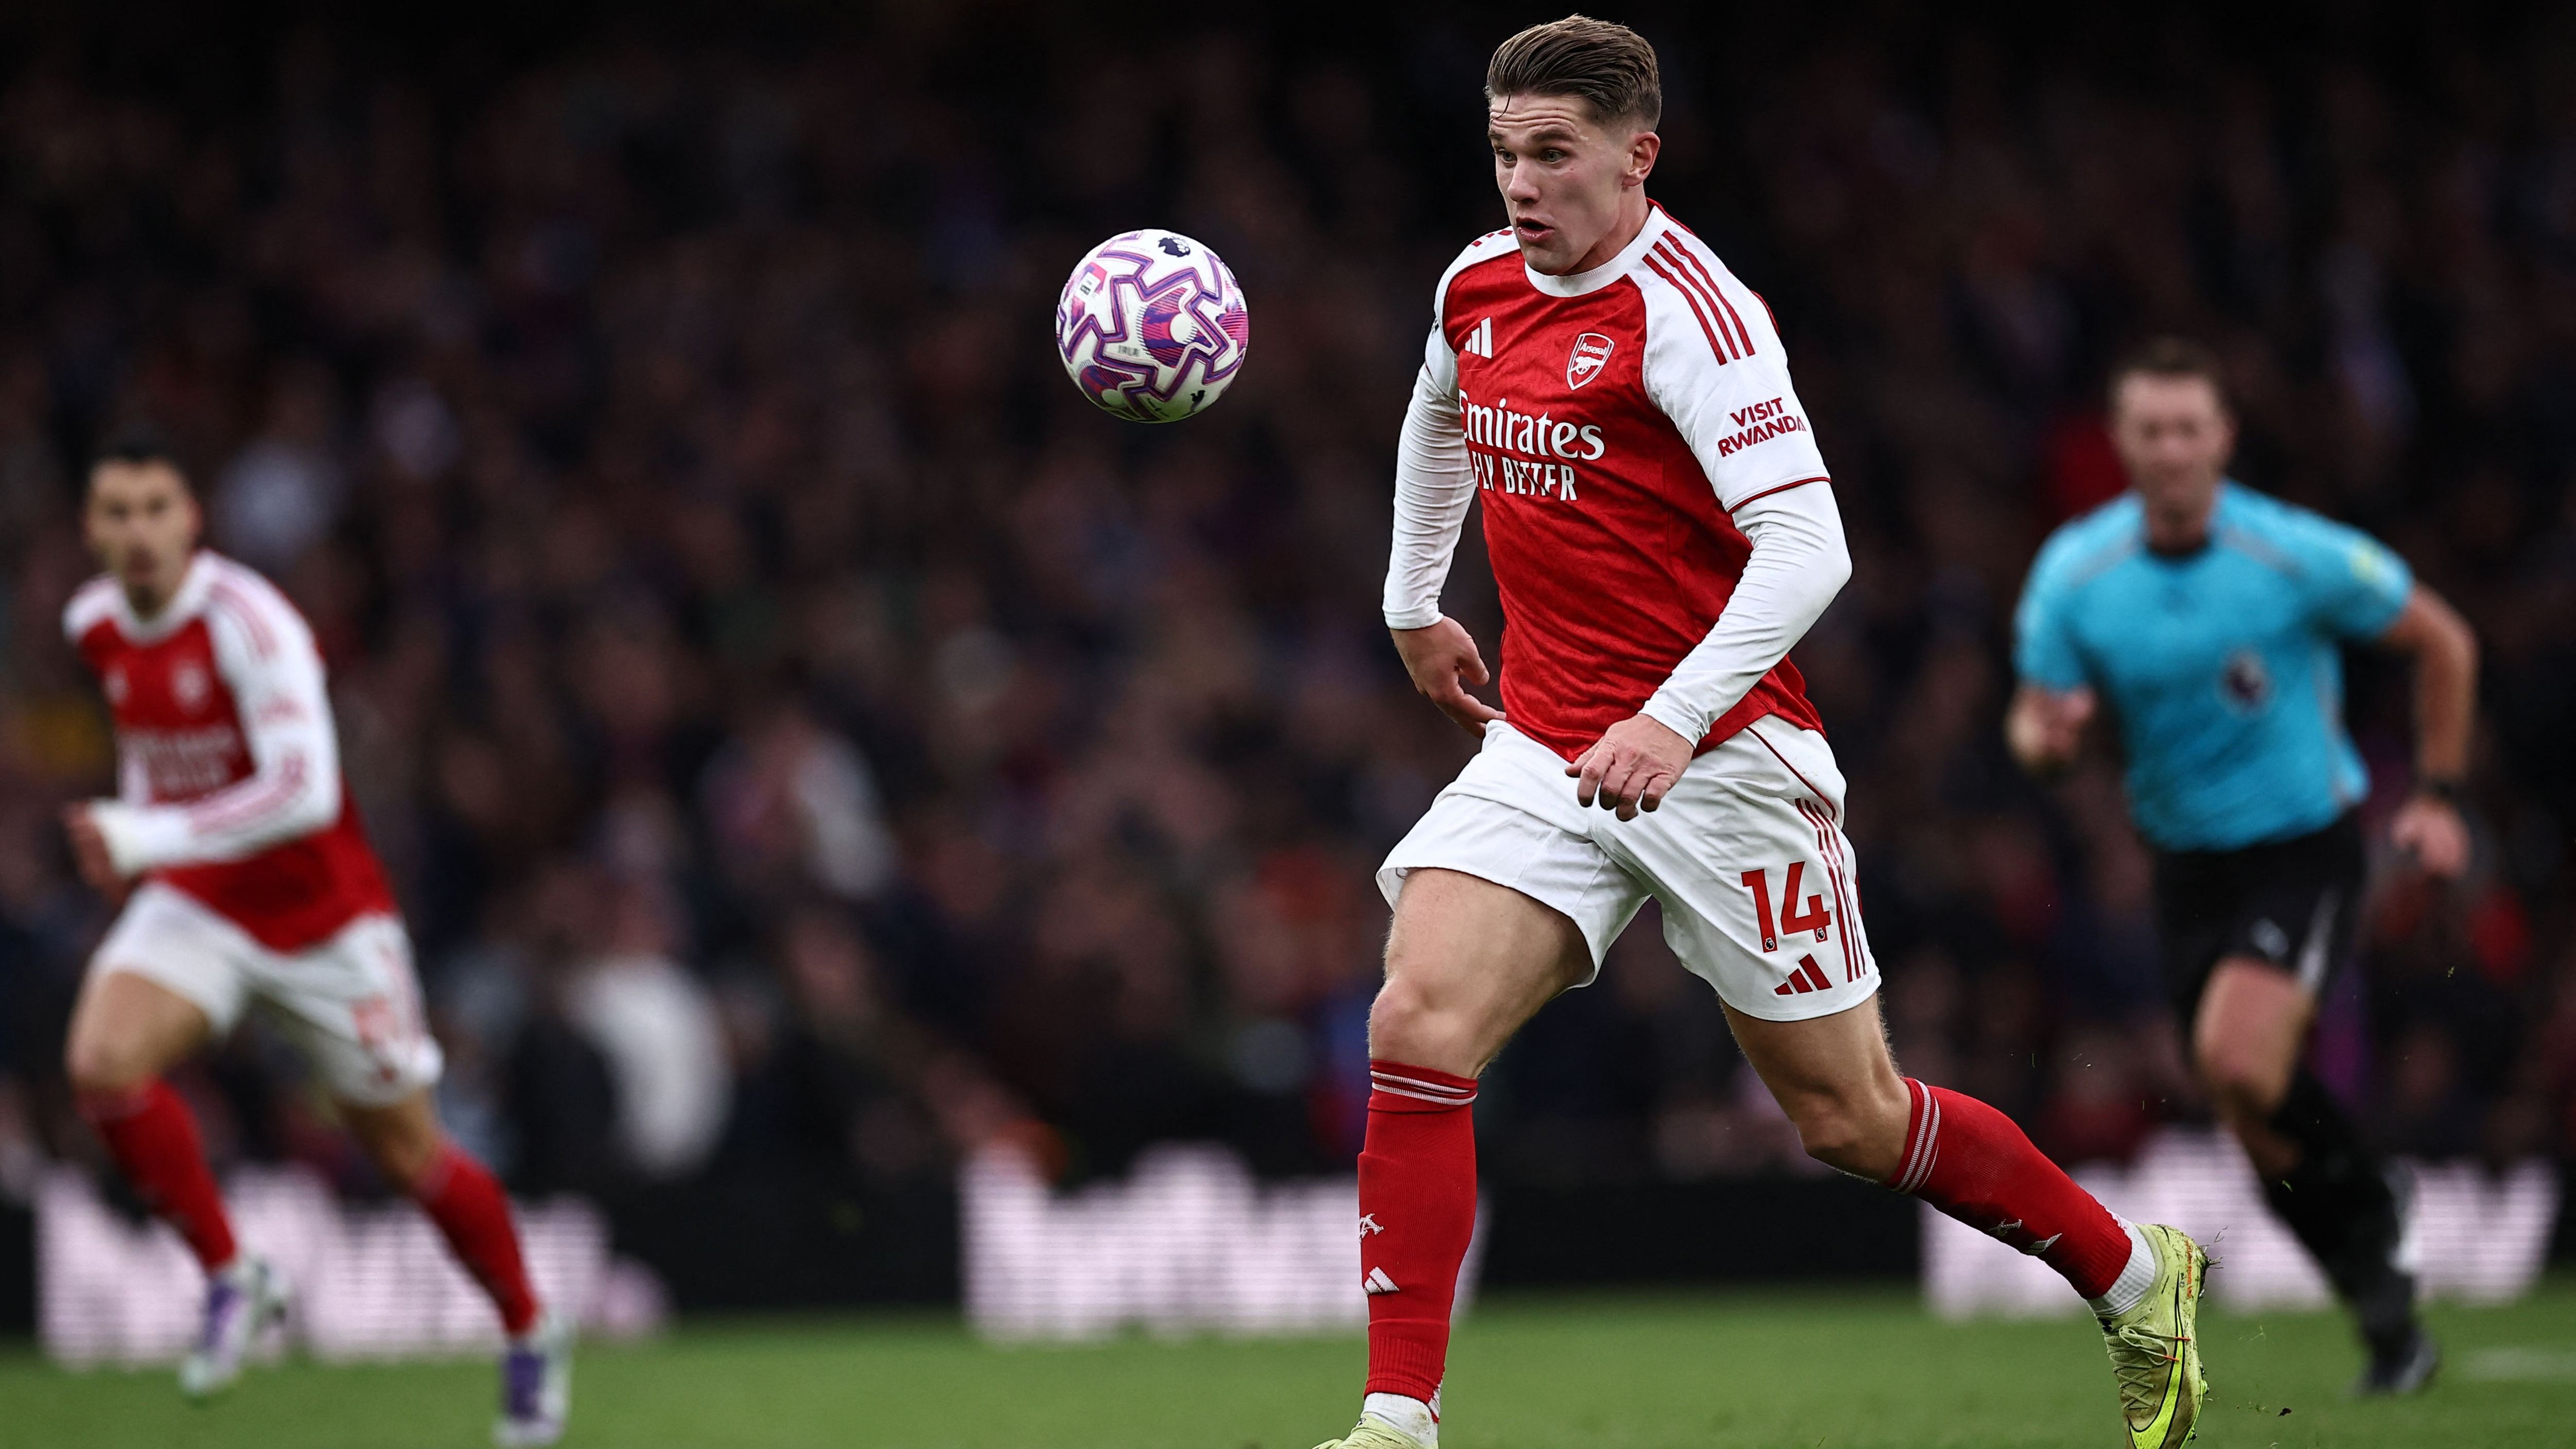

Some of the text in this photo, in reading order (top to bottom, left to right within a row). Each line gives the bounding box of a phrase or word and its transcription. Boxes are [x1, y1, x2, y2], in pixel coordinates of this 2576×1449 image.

[1729, 397, 1783, 427] VISIT
[1718, 415, 1807, 457] RWANDA
[1472, 451, 1577, 501] FLY BETTER
[1741, 861, 1831, 953] 14
